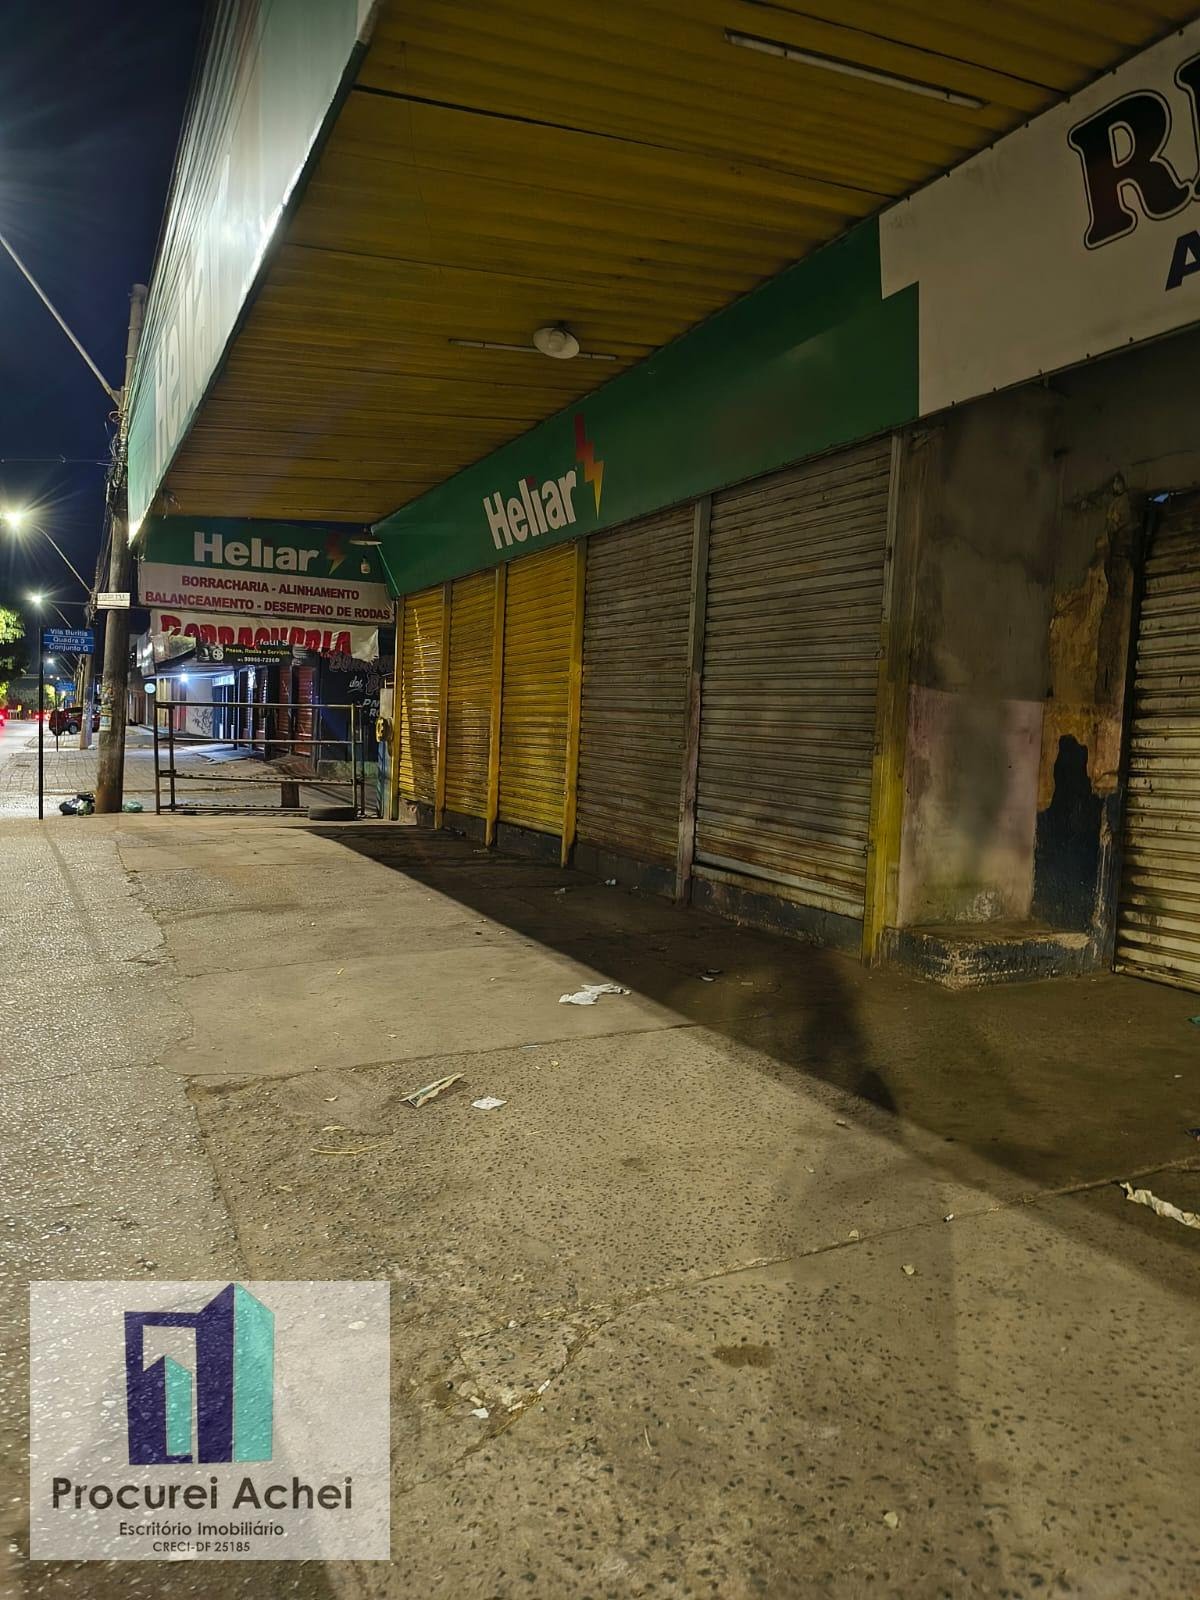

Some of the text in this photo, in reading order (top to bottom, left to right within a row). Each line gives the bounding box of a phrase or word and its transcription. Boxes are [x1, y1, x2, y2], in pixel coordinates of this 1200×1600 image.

[482, 469, 577, 550] Heliar
[194, 531, 319, 572] Heliar
[181, 575, 269, 593] BORRACHARIA
[278, 583, 360, 600] ALINHAMENTO
[145, 591, 254, 610] BALANCEAMENTO
[264, 601, 334, 616] DESEMPENO
[337, 605, 352, 617] DE
[354, 607, 390, 620] RODAS
